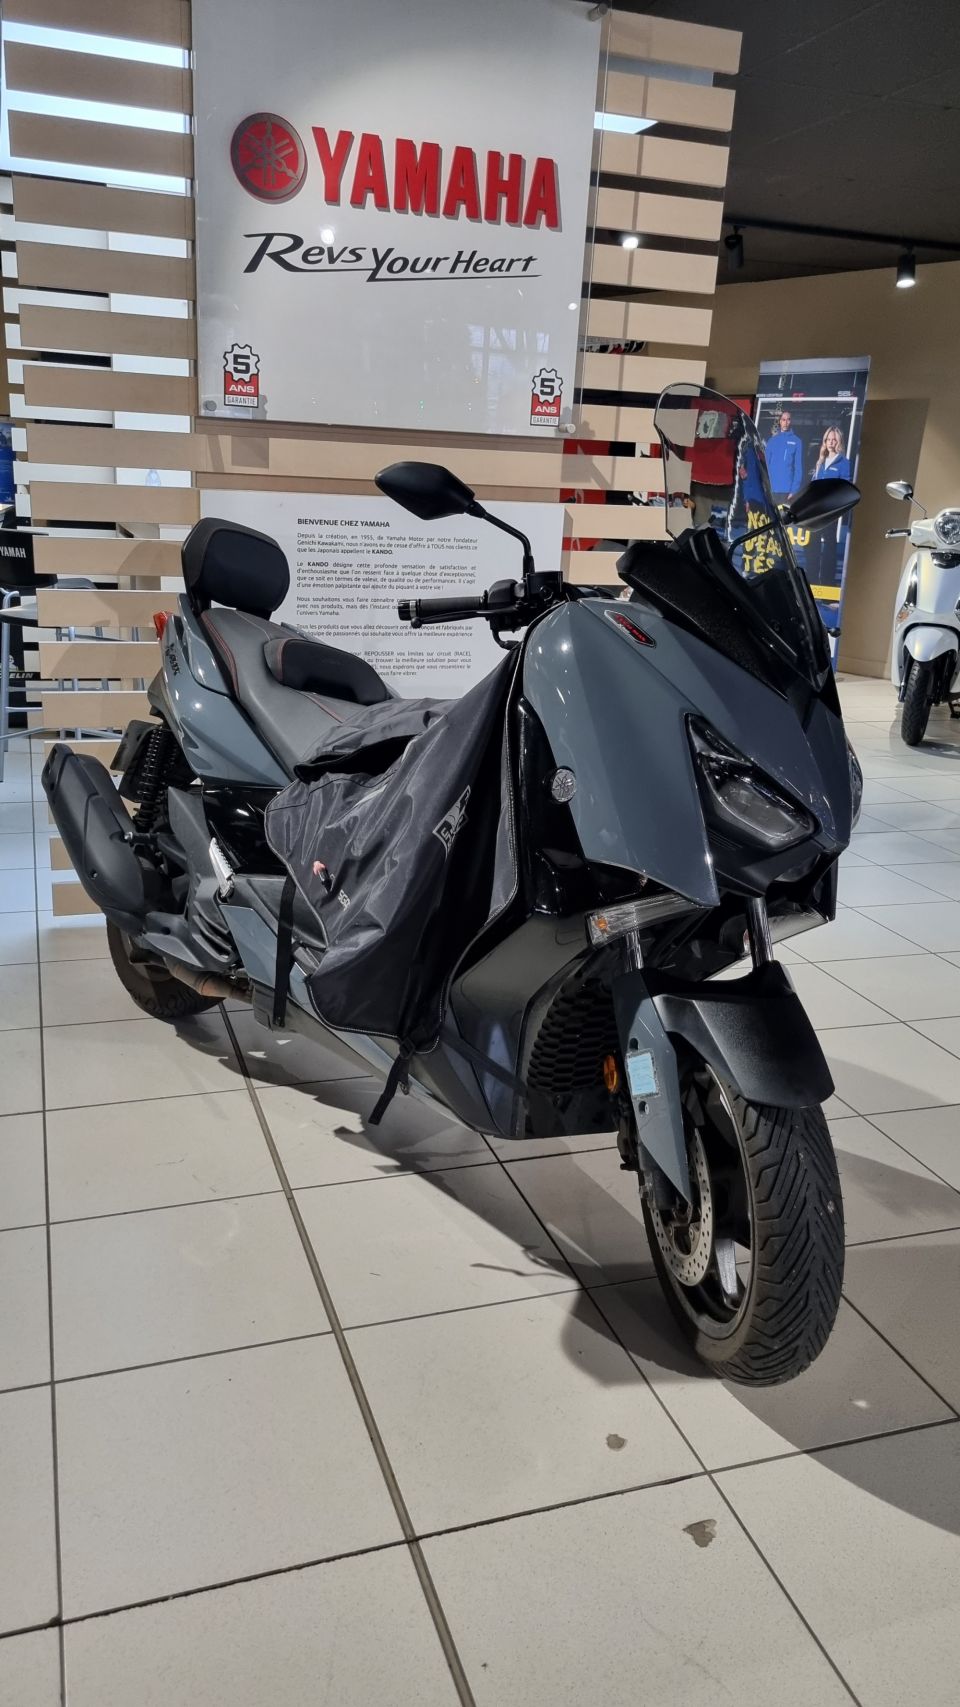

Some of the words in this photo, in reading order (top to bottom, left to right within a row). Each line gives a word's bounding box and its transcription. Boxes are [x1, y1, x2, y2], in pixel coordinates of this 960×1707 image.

[312, 126, 562, 230] YAMAHA
[243, 232, 367, 274] Revs
[449, 250, 538, 275] Heart
[232, 355, 251, 374] 5
[228, 384, 255, 393] ANS
[539, 377, 555, 396] 5
[226, 395, 257, 406] GARANTIE
[534, 405, 558, 414] ANS
[532, 416, 558, 424] GARANTIE
